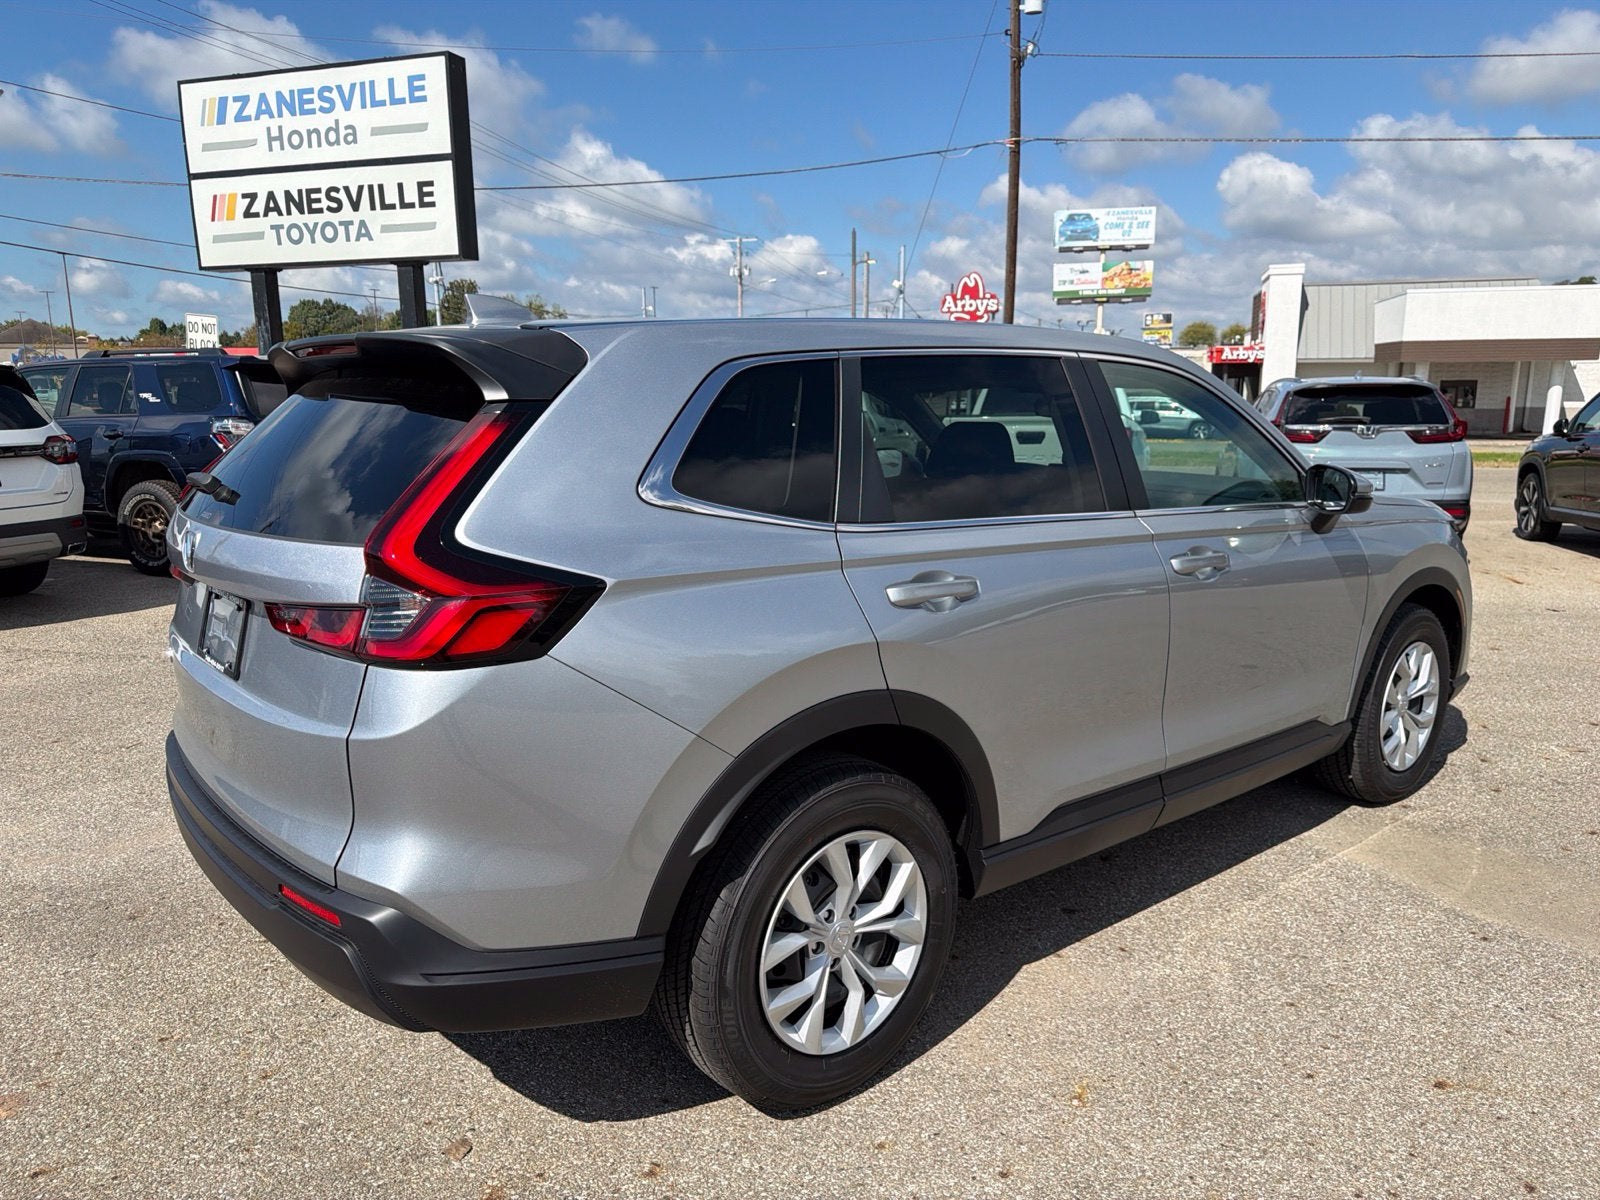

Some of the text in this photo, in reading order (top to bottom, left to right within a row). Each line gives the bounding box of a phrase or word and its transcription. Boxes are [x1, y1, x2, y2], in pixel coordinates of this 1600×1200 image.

[232, 73, 428, 123] ZANESVILLE
[266, 119, 358, 152] Honda
[241, 180, 436, 220] ZANESVILLE
[270, 219, 374, 246] TOYOTA
[1104, 221, 1126, 230] COME
[942, 293, 998, 316] Arby's
[188, 321, 216, 335] DO NOT
[1221, 345, 1265, 363] Arby's
